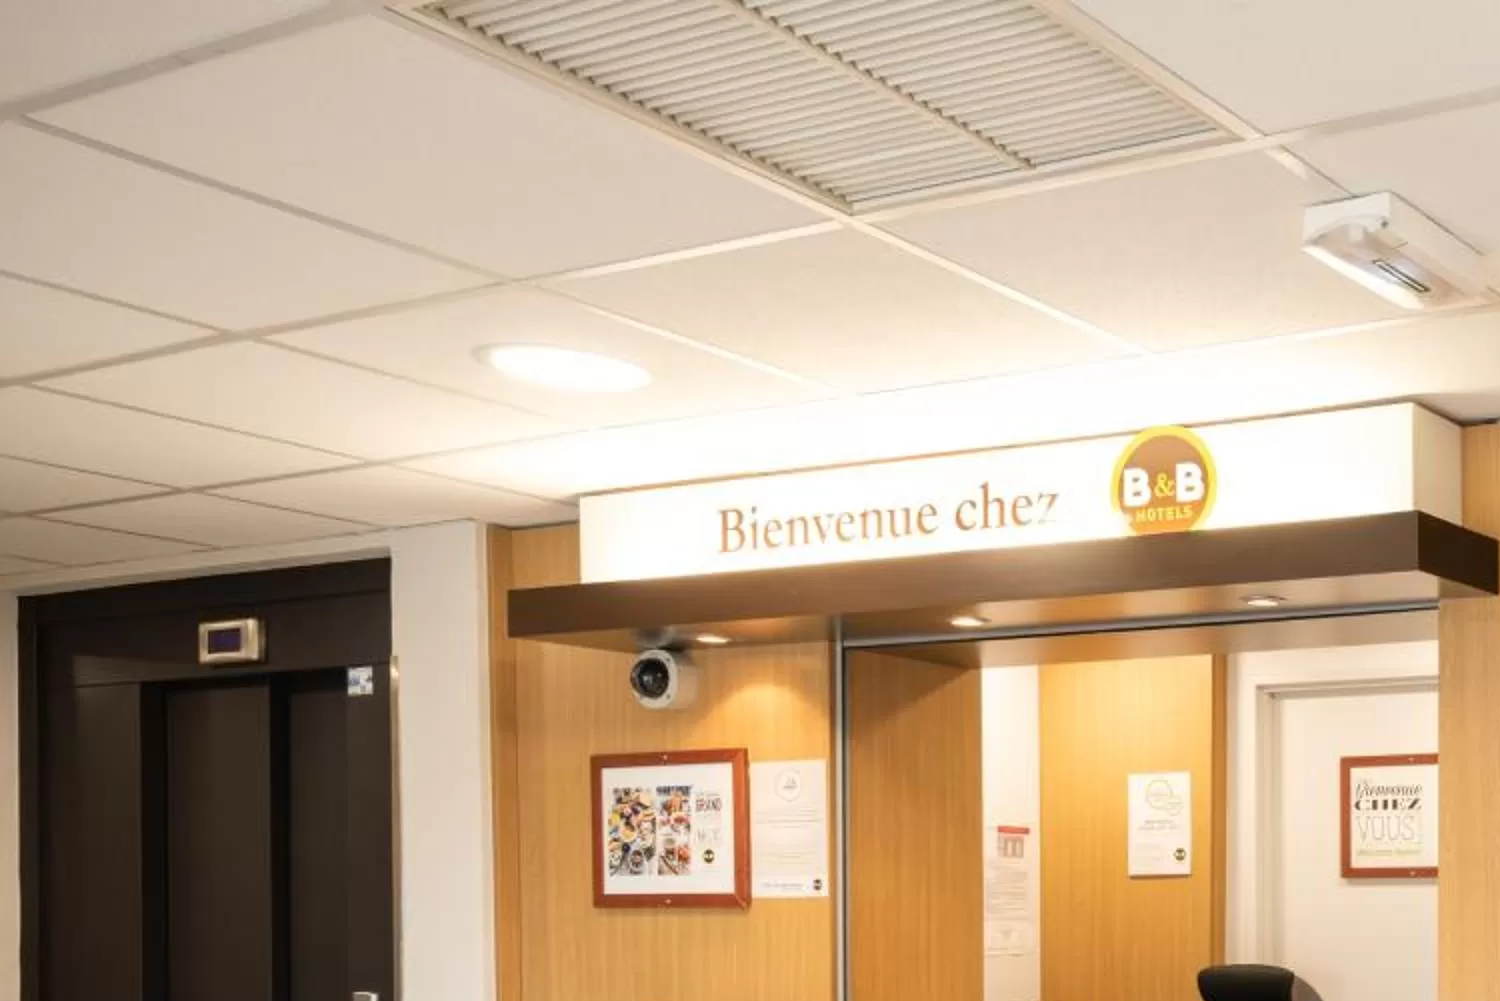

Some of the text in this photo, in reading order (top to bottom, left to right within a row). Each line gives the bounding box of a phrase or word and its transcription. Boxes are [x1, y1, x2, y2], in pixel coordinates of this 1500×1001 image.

[1123, 462, 1205, 508] B&B
[718, 480, 1059, 553] Bienvenue chez
[1135, 504, 1193, 523] HOTELS
[1355, 798, 1422, 811] CHEZ
